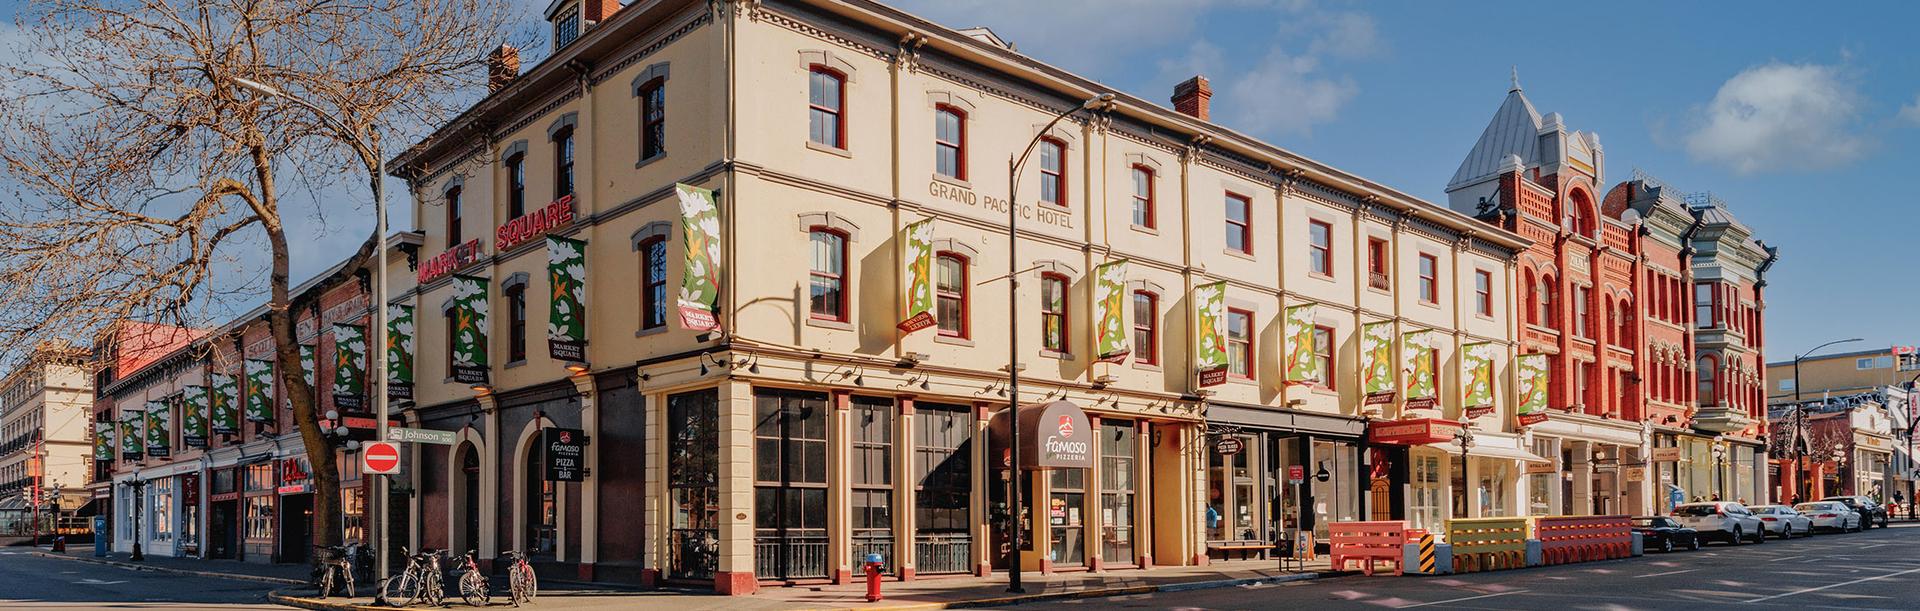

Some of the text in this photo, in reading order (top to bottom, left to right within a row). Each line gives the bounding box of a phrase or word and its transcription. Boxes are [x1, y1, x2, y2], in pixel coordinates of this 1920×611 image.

[929, 182, 977, 206] GRAND
[1037, 208, 1074, 229] HOTEL
[496, 195, 573, 250] SQUARE
[685, 310, 715, 321] MARKET
[553, 343, 580, 351] MARKET
[553, 349, 581, 358] SQUARE
[458, 368, 484, 377] MARKET
[1203, 371, 1224, 379] MARKET
[458, 374, 484, 382] SQUARE
[405, 430, 438, 440] Johnson
[556, 458, 575, 467] PIZZA
[558, 471, 572, 479] BAR
